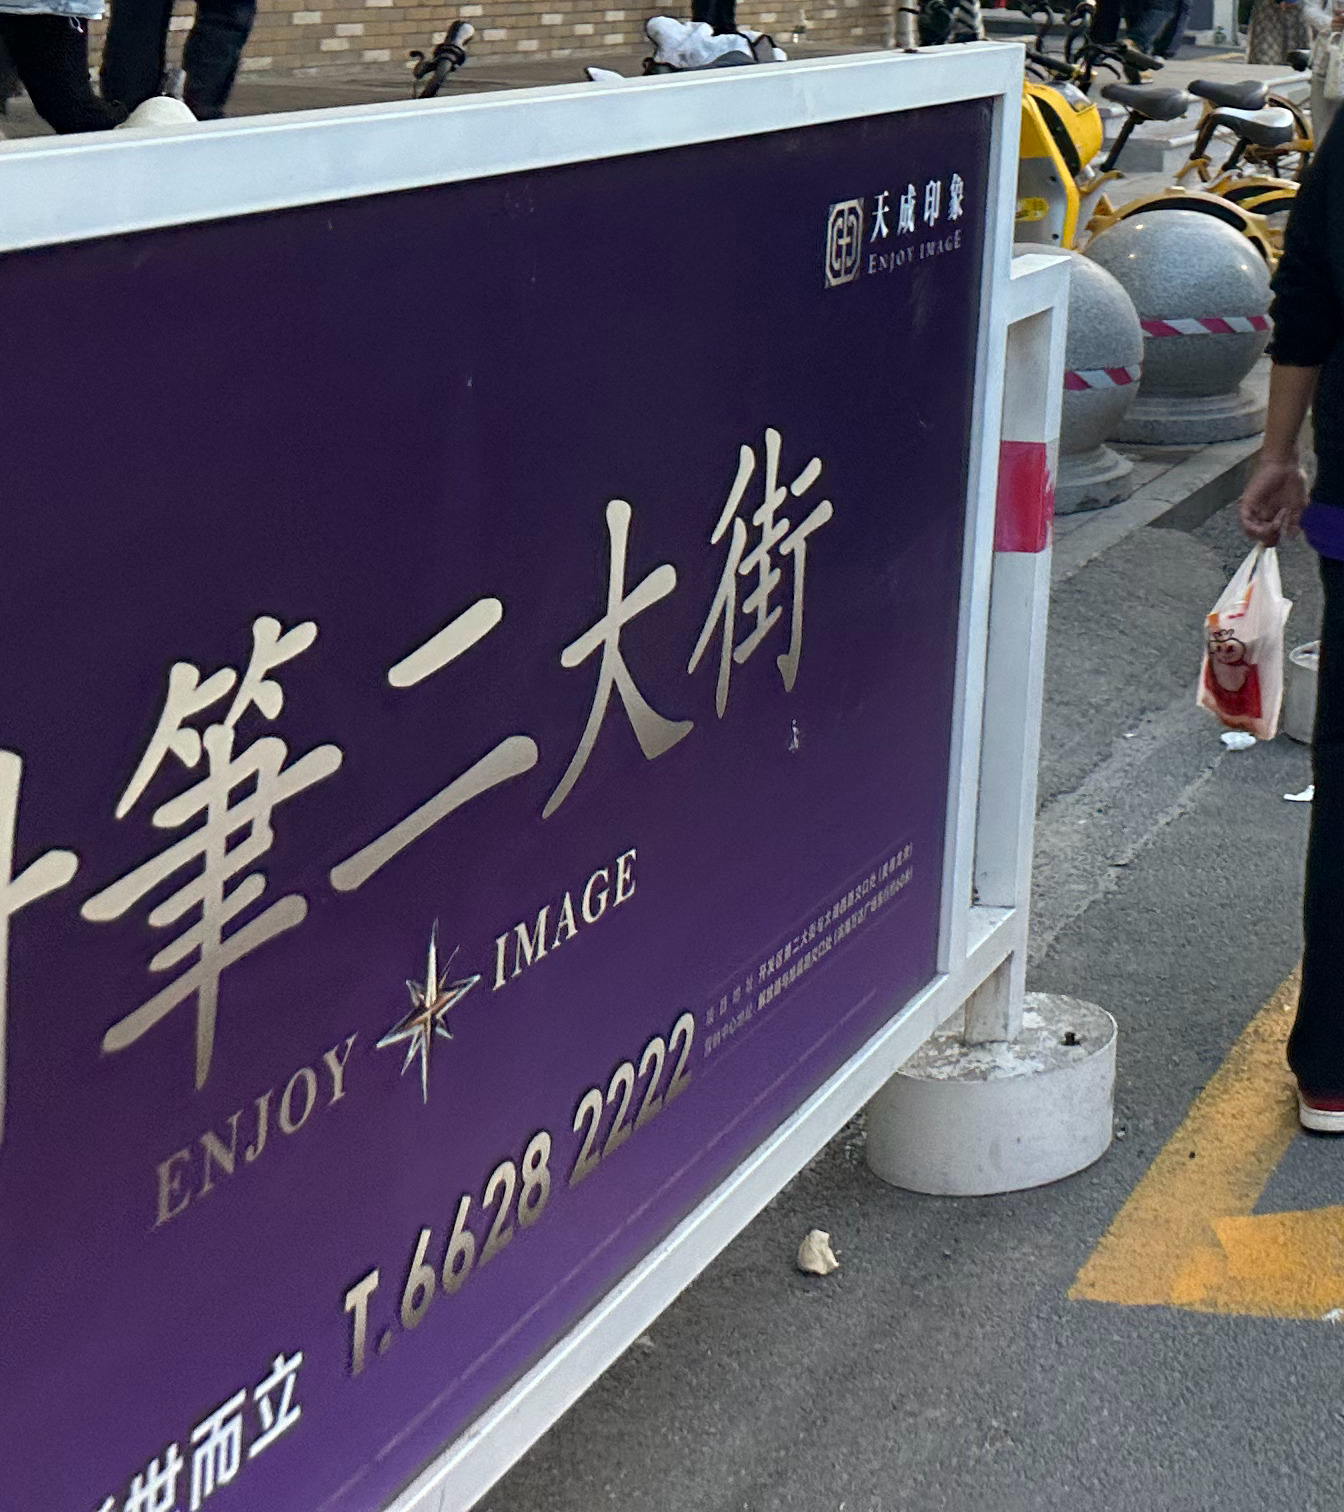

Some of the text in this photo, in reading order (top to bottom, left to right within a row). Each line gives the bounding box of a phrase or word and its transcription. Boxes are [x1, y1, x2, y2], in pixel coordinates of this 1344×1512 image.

[868, 228, 962, 275] ENJOY IMAGE
[153, 1031, 359, 1234] ENJOY
[492, 848, 638, 992] IMAGE
[343, 1011, 696, 1377] T.6628 2222
[95, 1350, 304, 1512] 世而立
